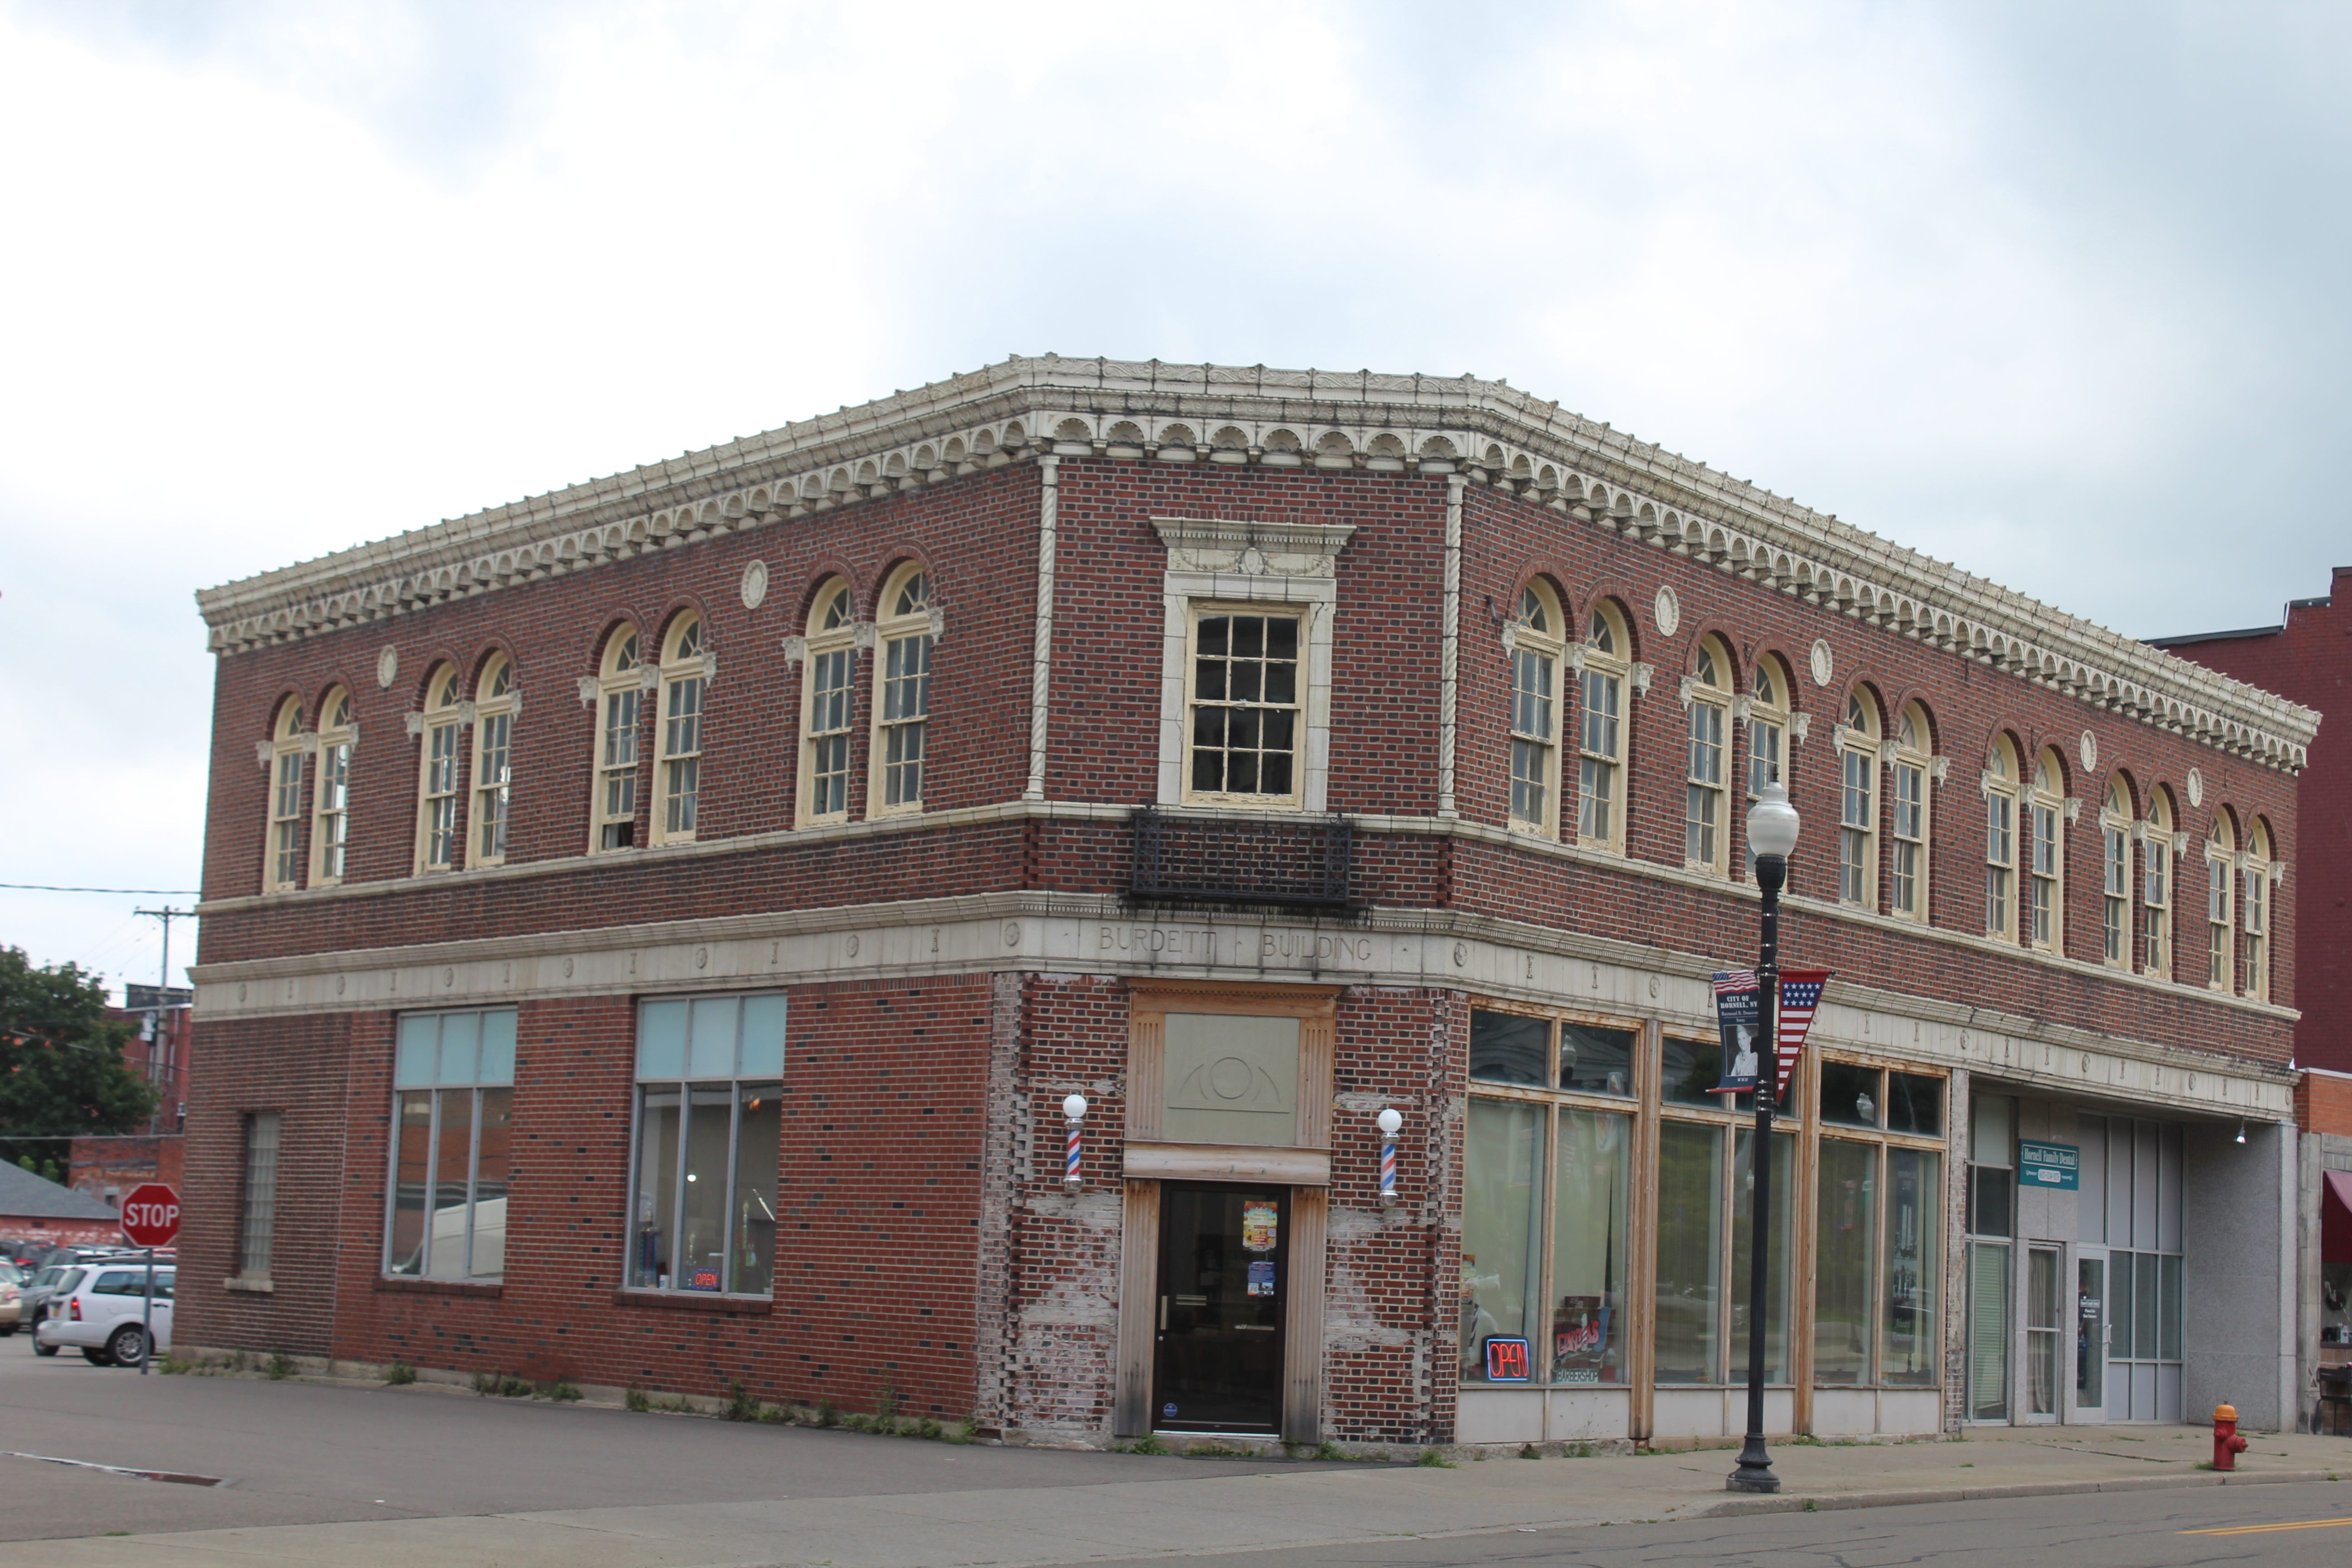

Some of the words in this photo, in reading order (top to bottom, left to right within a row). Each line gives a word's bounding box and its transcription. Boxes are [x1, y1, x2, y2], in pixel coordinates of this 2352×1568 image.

[1100, 927, 1216, 954] BURDETT
[1263, 935, 1371, 960] BUILDING
[2024, 1148, 2042, 1161] Hornell
[2043, 1151, 2058, 1166] Family
[2059, 1152, 2075, 1166] Dental
[125, 1204, 179, 1227] STOP
[696, 1274, 717, 1285] OPEN
[1490, 1343, 1528, 1377] OPEN
[1558, 1369, 1598, 1382] BARBERSHOP
